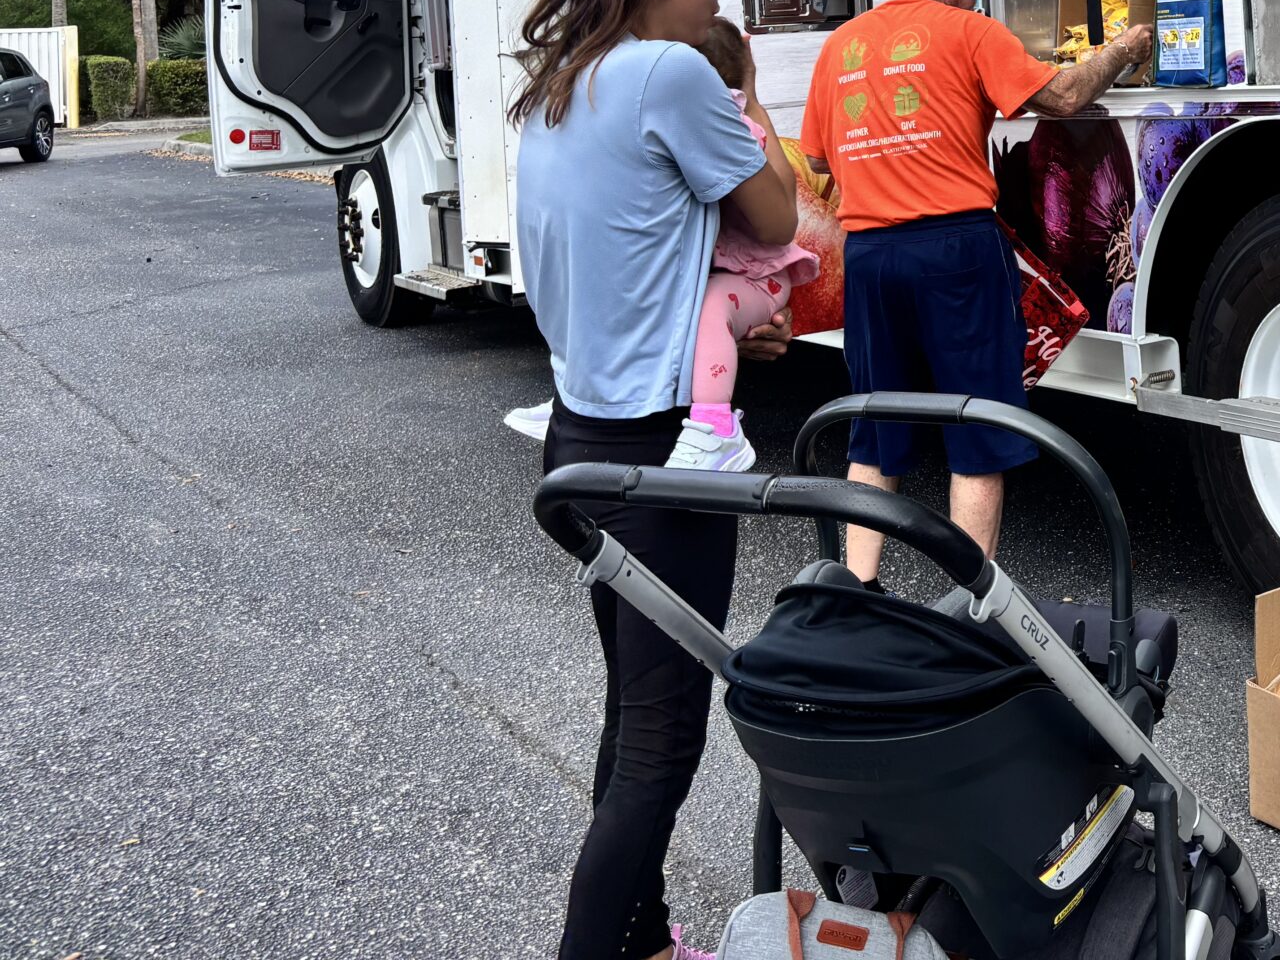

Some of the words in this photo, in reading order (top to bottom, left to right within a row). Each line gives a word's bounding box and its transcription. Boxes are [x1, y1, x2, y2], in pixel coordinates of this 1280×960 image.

[883, 64, 906, 76] DONATE
[907, 63, 926, 73] FOOD
[900, 120, 917, 131] GIVE
[1020, 614, 1050, 651] CRUZ
